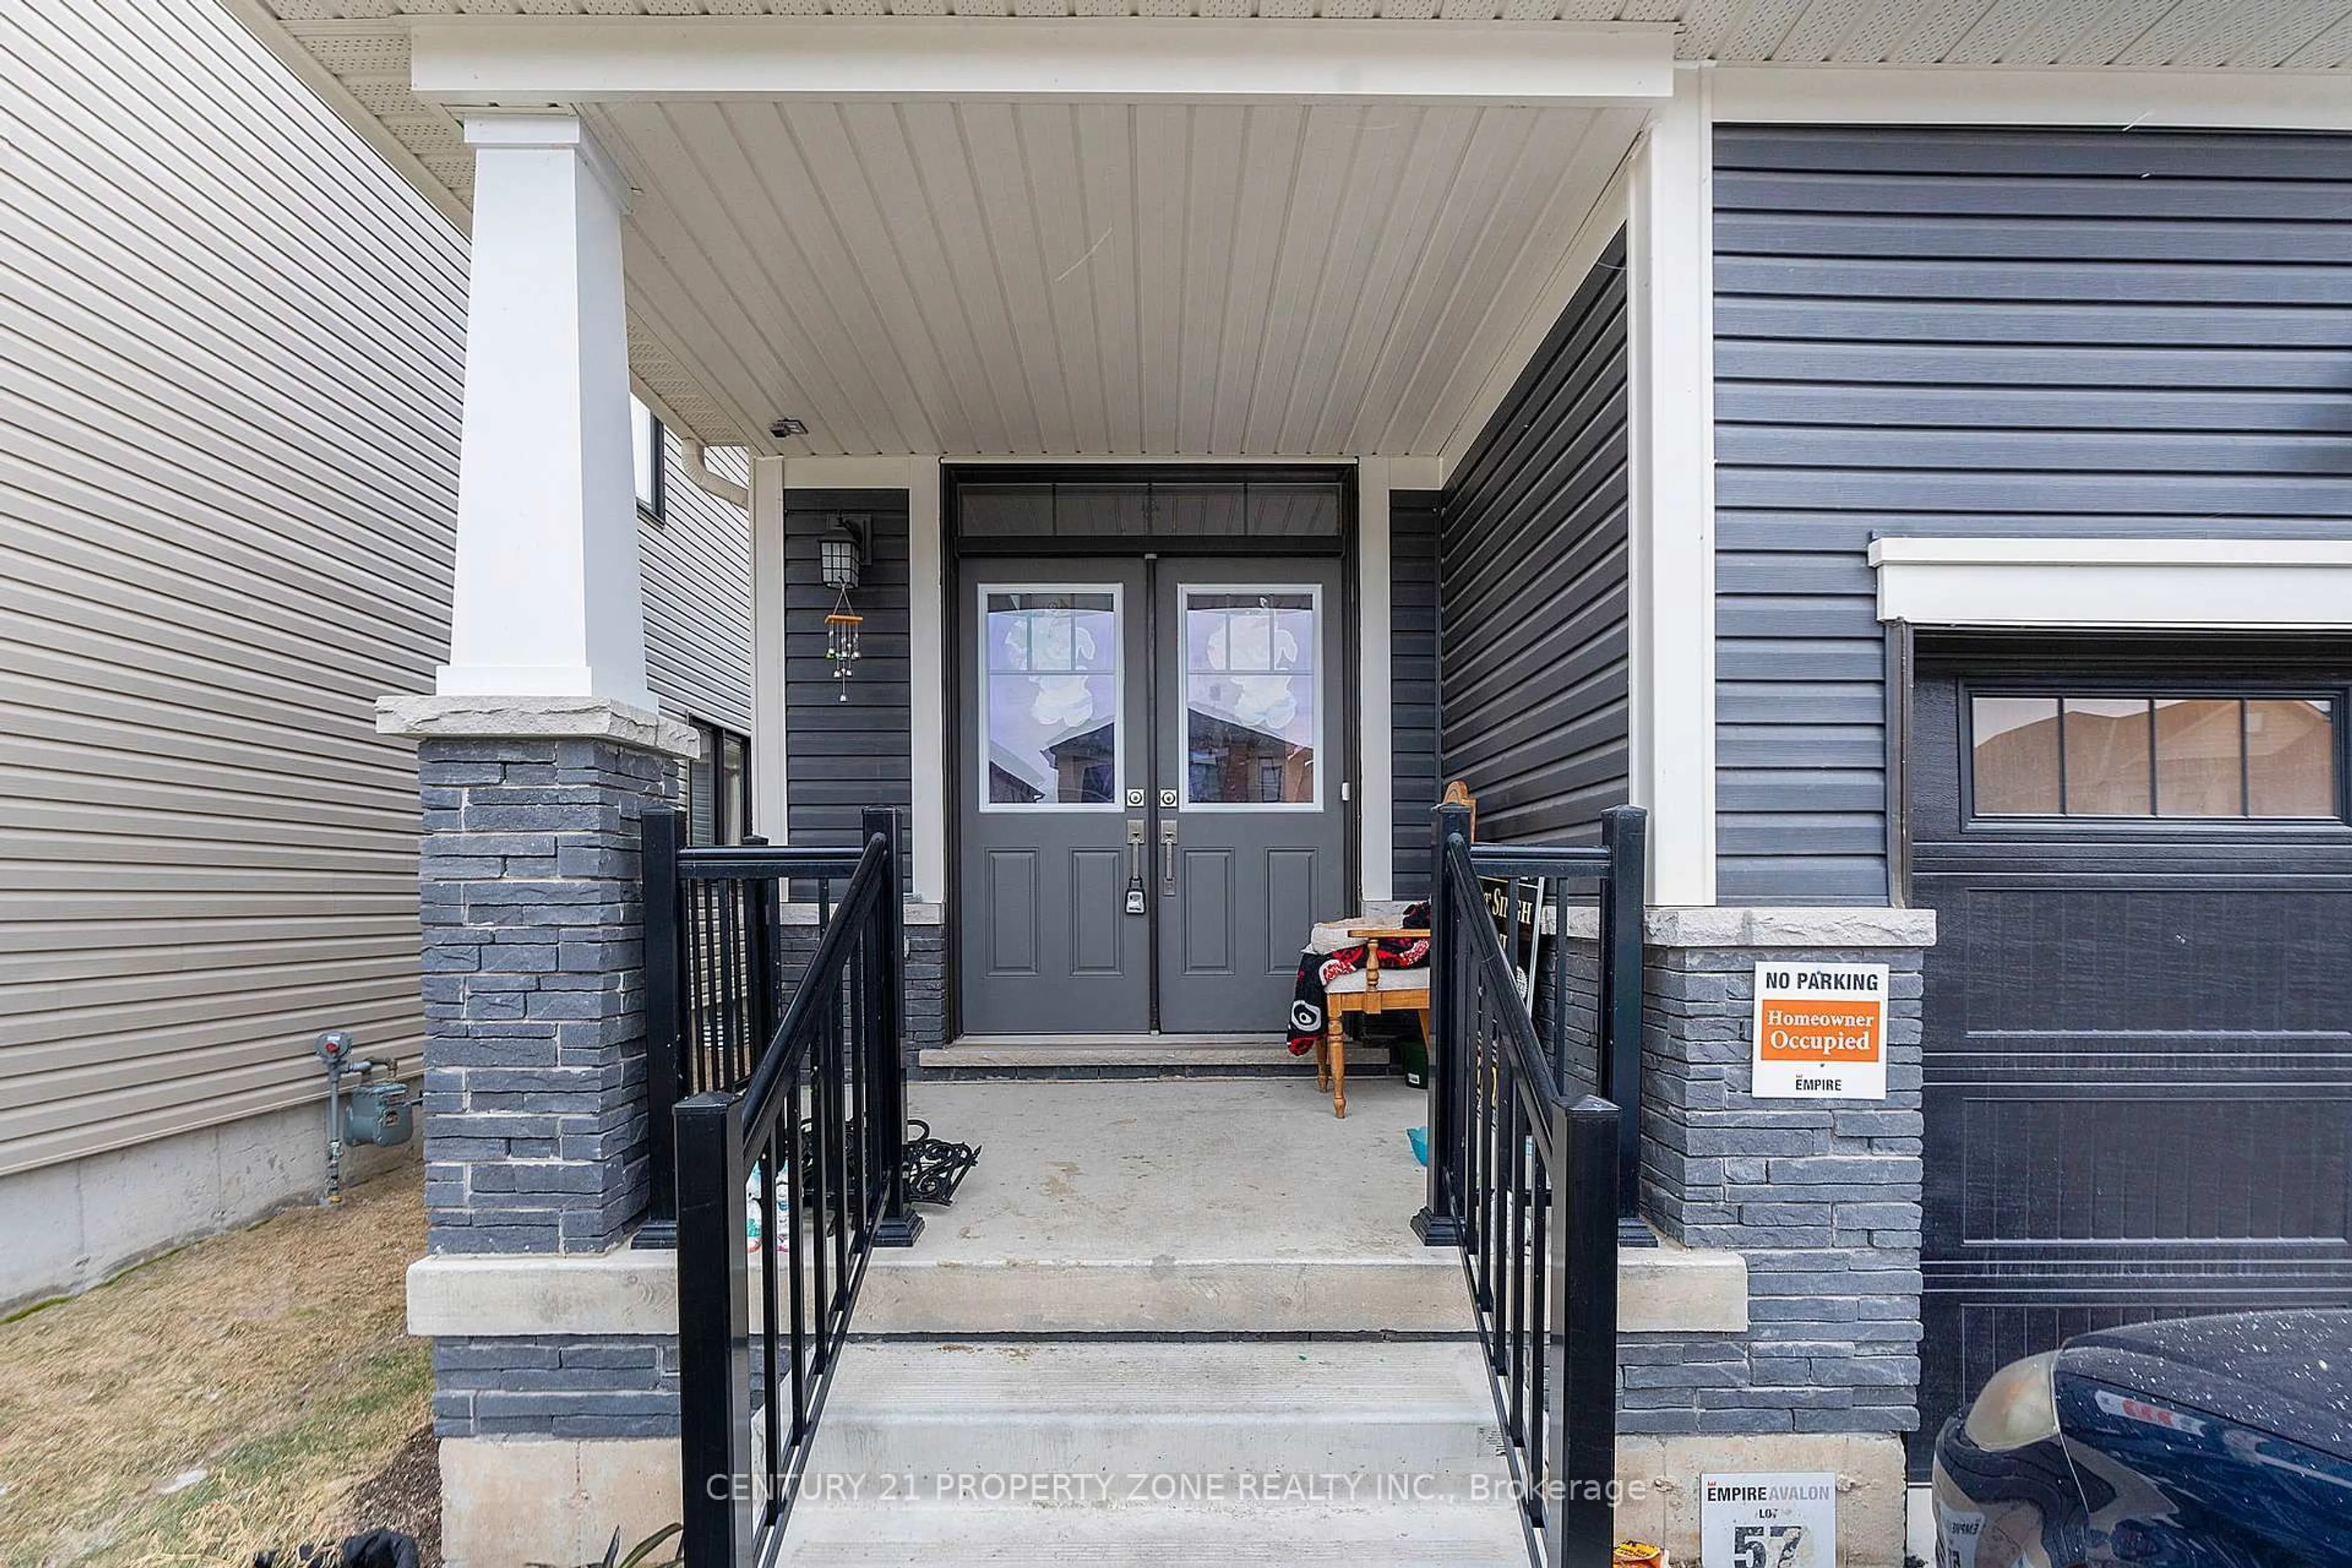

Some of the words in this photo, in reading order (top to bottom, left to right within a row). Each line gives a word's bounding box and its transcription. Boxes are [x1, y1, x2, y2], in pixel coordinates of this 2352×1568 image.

[1766, 972, 1789, 989] NO
[1797, 972, 1878, 990] PARKING
[1768, 1010, 1874, 1027] Homeowner
[1771, 1030, 1870, 1055] Occupied
[1795, 1079, 1842, 1091] EMPIRE
[1708, 1487, 1766, 1501] EMPIRE
[1770, 1487, 1829, 1500] AVALON
[1734, 1526, 1802, 1568] 57
